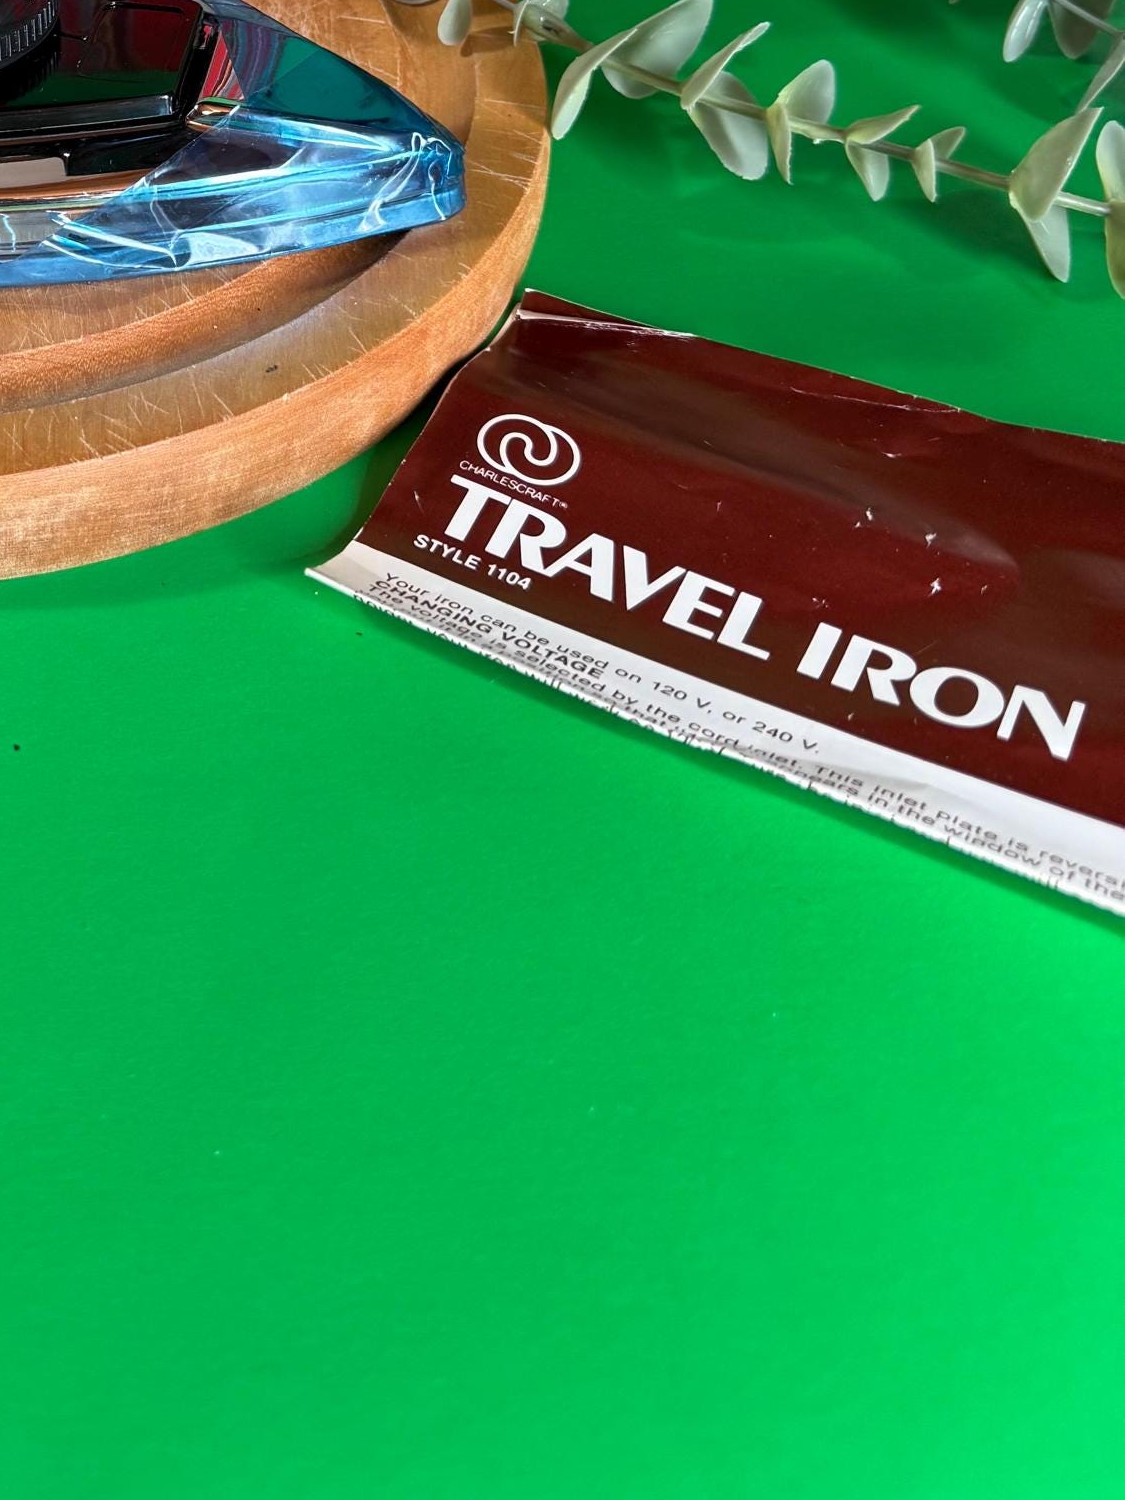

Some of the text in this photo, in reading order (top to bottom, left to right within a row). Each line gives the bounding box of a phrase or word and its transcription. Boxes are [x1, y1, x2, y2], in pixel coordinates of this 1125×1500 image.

[375, 579, 493, 634] CHANGING
[501, 631, 606, 680] VOLTAGE
[413, 534, 533, 591] STYLE 1104
[444, 474, 1086, 762] TRAVEL IRON
[369, 583, 404, 604] The
[411, 605, 484, 638] voltage
[490, 638, 508, 650] is
[515, 649, 607, 693] selected
[612, 689, 639, 709] by
[645, 703, 681, 724] the
[688, 722, 740, 749] cord
[815, 764, 864, 788] This
[874, 785, 928, 811] inlet
[935, 810, 999, 842] plate
[1006, 837, 1030, 852] is
[385, 572, 431, 596] Your
[433, 593, 475, 615] iron
[480, 613, 518, 633] can
[523, 629, 551, 646] be
[556, 644, 610, 670] used
[614, 667, 643, 684] on
[651, 681, 689, 701] 120
[722, 710, 748, 726] or
[751, 719, 794, 744] 240
[802, 738, 820, 755] V.
[867, 792, 889, 809] in
[896, 803, 937, 827] the
[943, 824, 1042, 868] window
[1048, 866, 1076, 881] of
[1085, 877, 1125, 902] the
